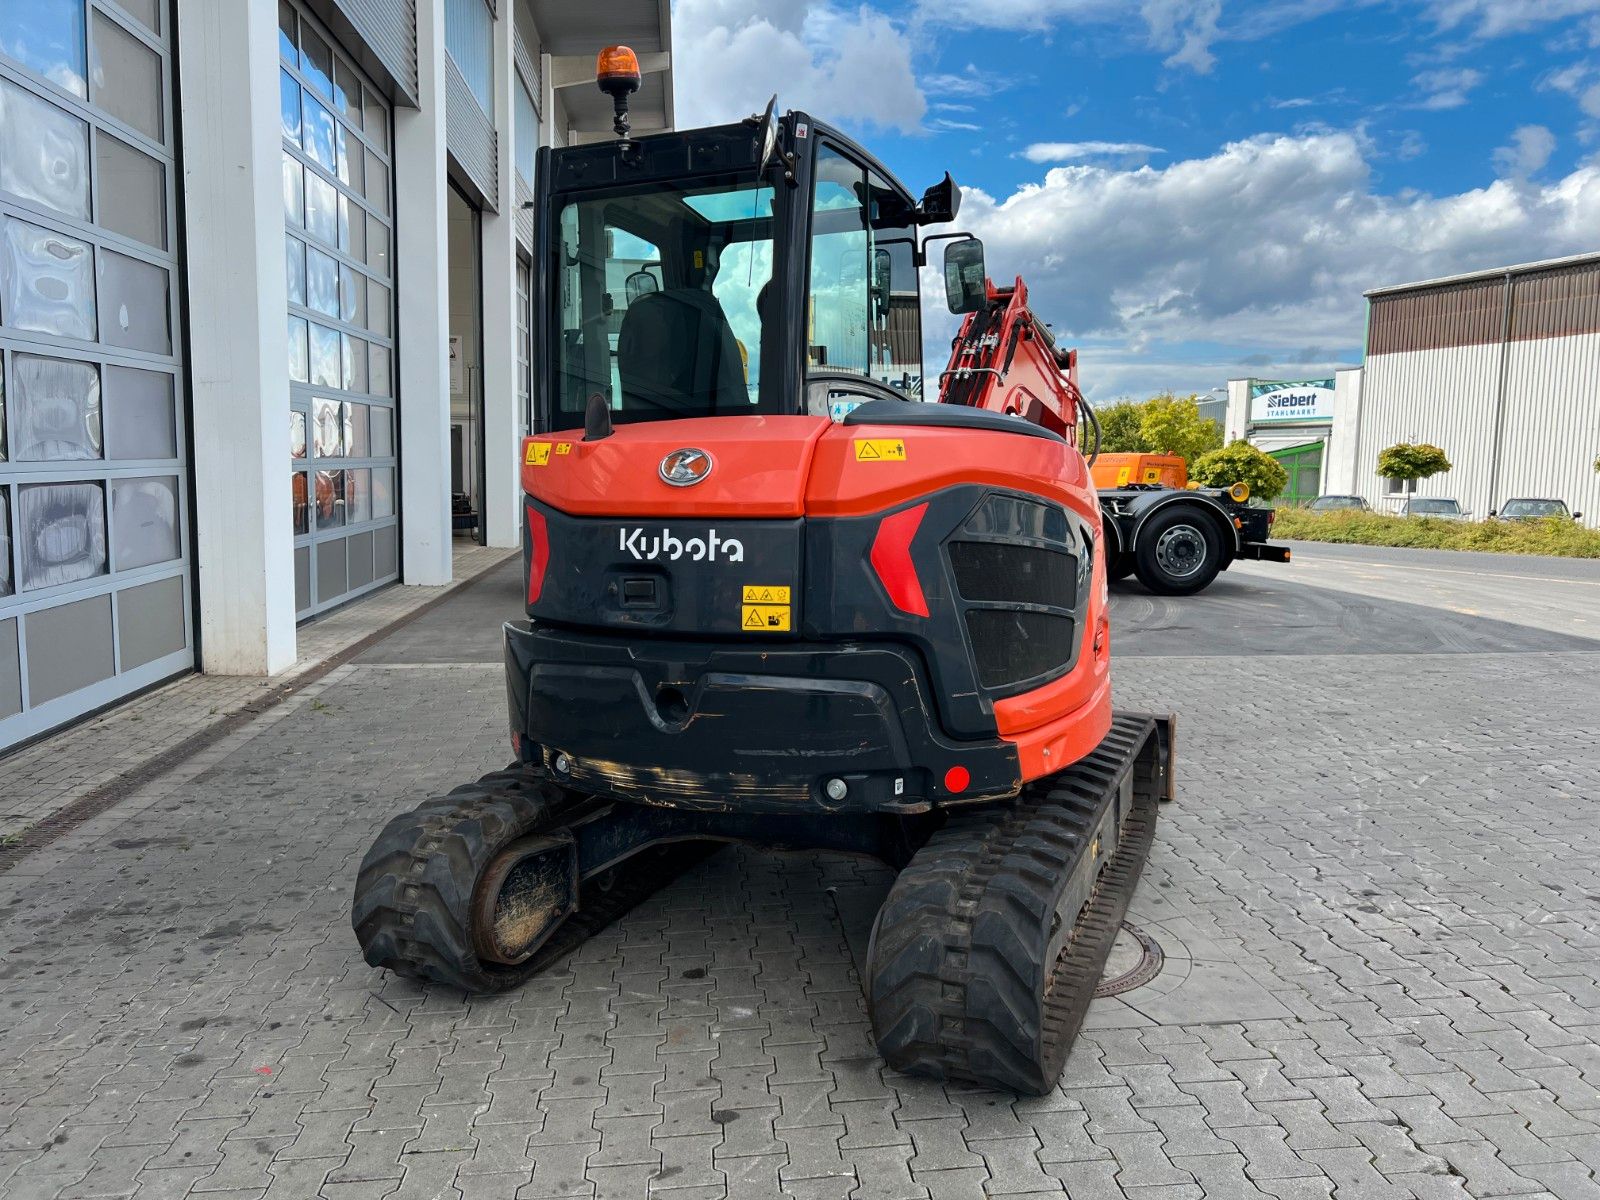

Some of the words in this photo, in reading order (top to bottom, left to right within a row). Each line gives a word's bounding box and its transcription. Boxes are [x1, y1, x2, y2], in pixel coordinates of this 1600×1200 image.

[1267, 392, 1317, 408] Siebert
[1266, 408, 1317, 417] STAHLMARKT
[619, 528, 744, 561] Kubota
